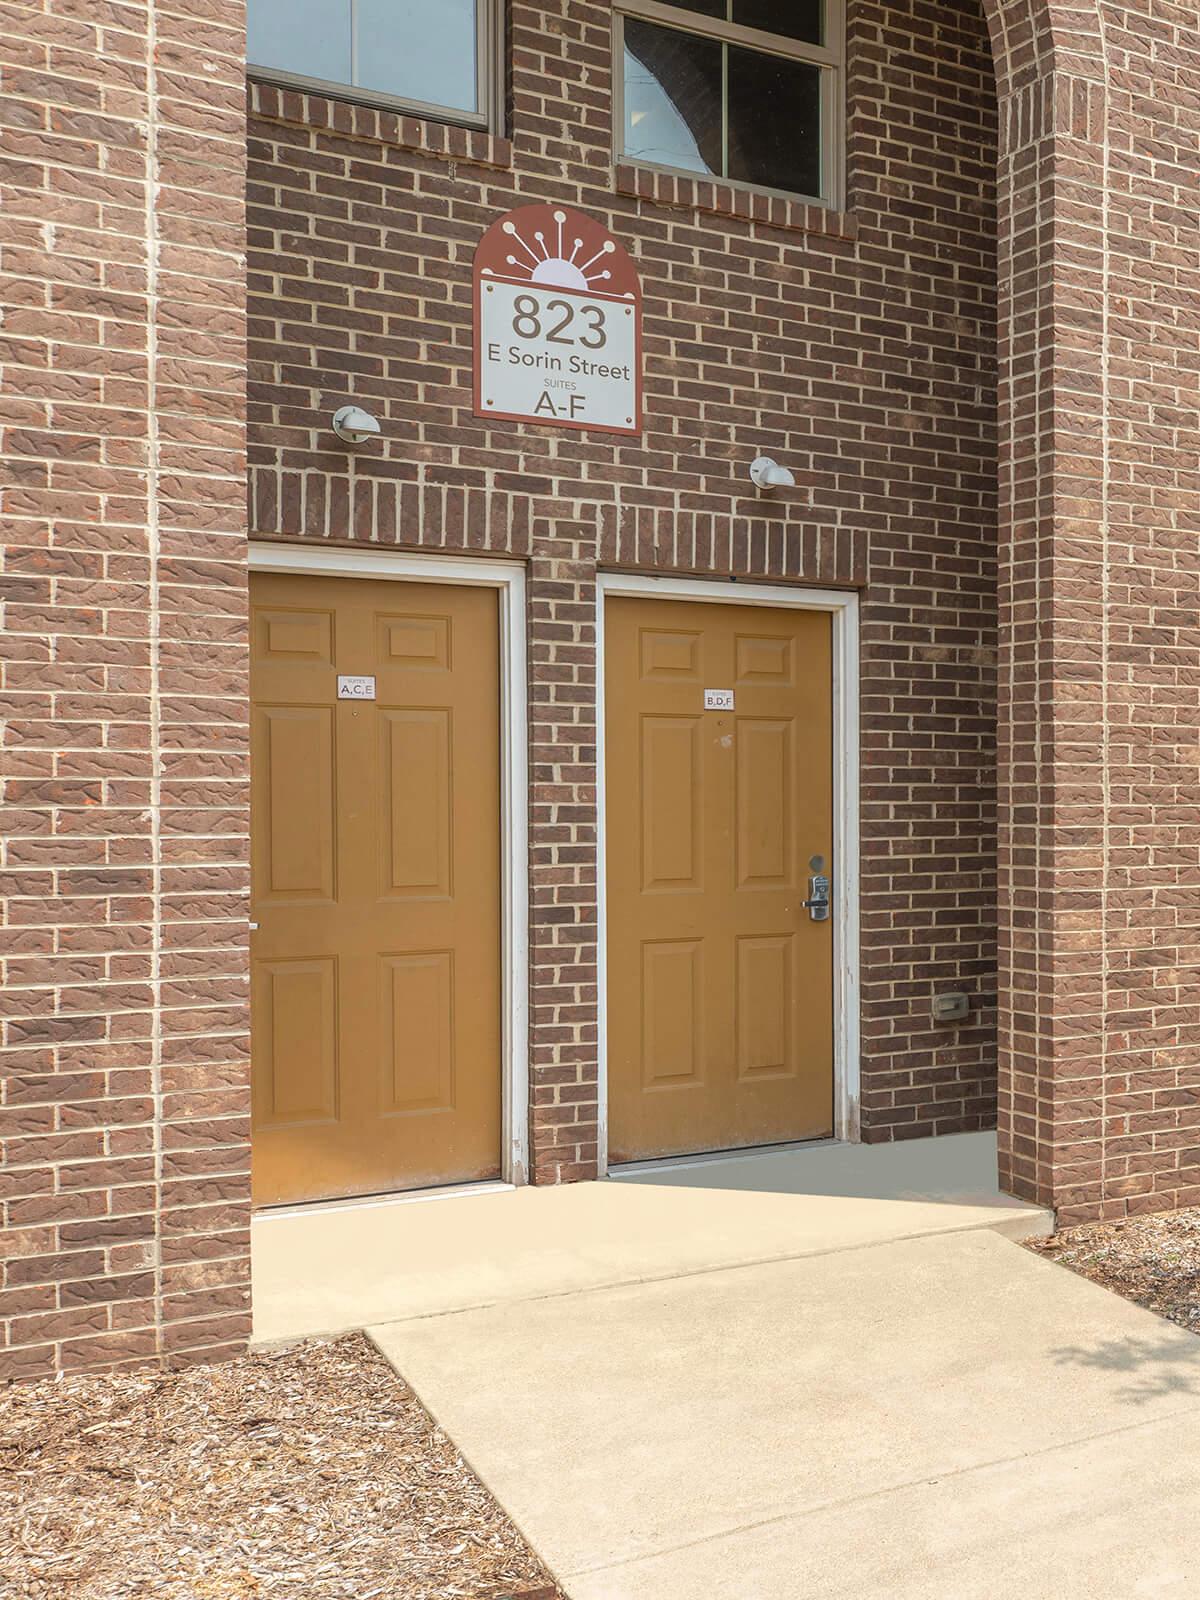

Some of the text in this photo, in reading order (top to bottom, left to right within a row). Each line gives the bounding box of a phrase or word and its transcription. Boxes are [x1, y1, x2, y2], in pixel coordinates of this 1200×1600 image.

[512, 294, 607, 349] 823
[488, 343, 630, 381] E Sorin Street
[544, 378, 577, 391] SUITES
[534, 391, 586, 418] A-F
